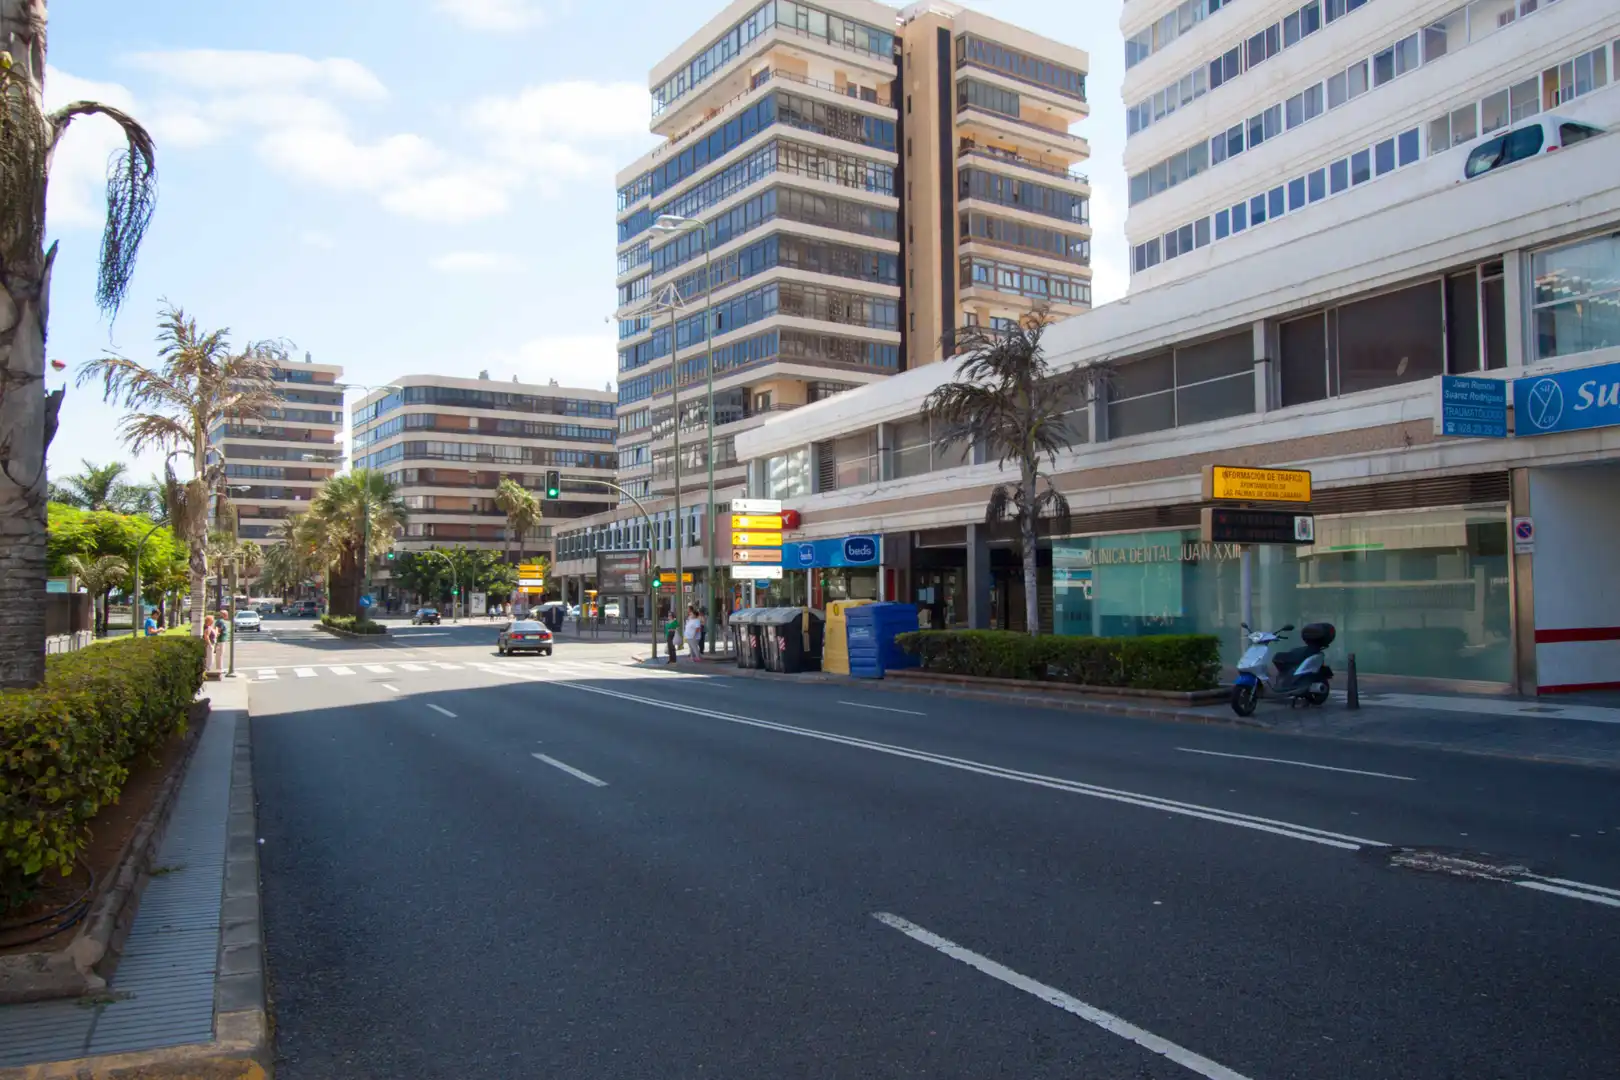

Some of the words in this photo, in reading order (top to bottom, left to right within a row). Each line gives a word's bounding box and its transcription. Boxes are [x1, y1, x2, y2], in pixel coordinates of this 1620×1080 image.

[1573, 380, 1620, 411] Su
[1129, 545, 1174, 563] DENTAL
[1178, 543, 1210, 561] JUAN
